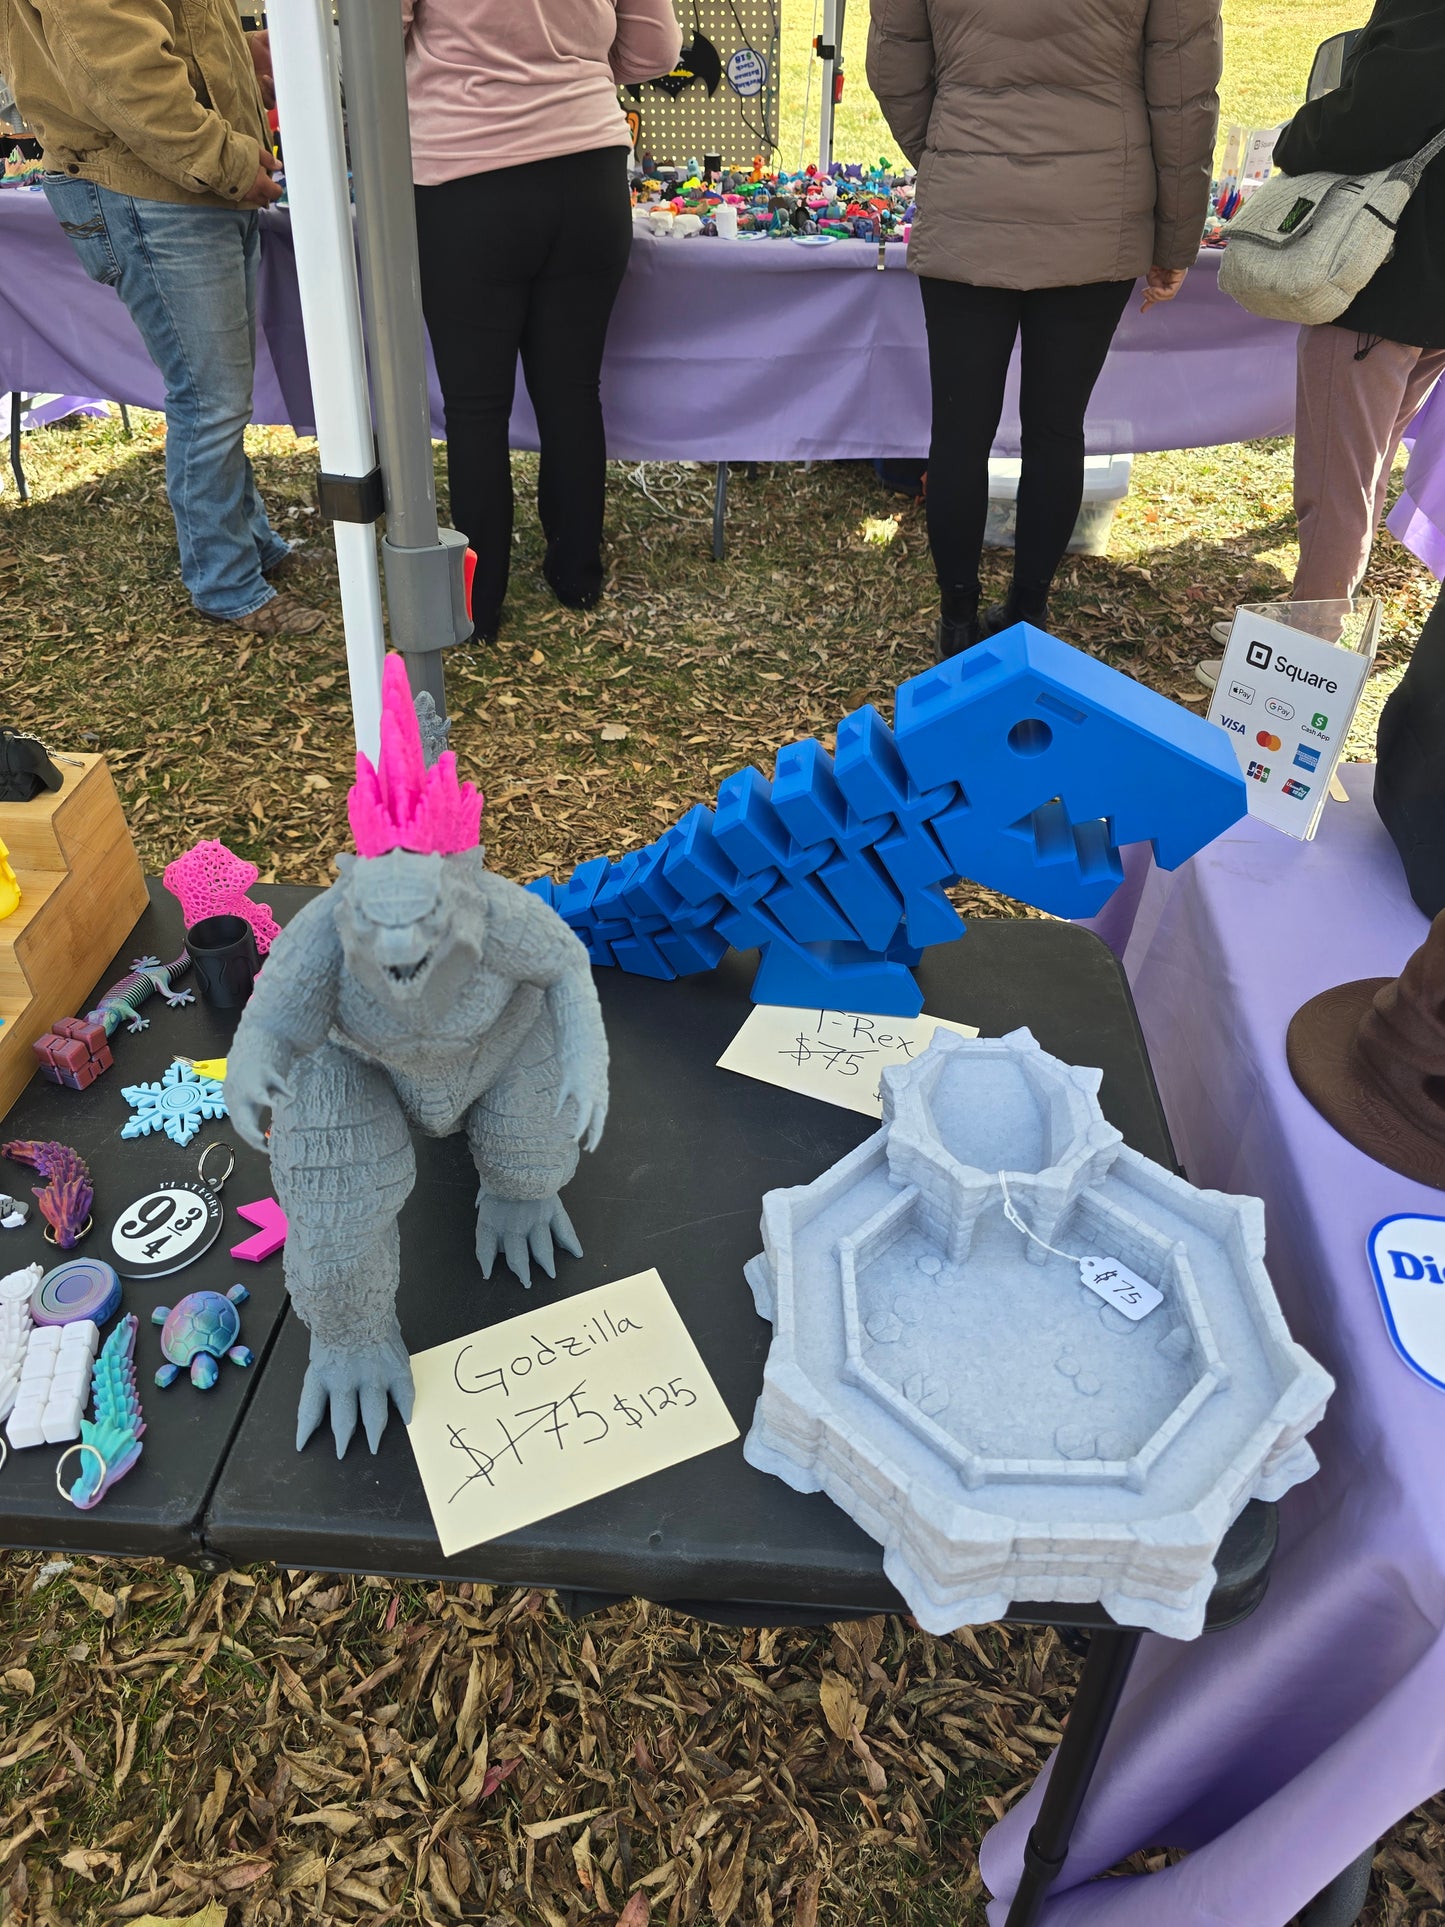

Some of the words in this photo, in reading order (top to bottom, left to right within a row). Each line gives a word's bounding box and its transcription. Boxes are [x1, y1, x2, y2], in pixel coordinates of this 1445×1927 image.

[734, 69, 760, 80] Batman
[736, 61, 755, 71] Clock
[1274, 655, 1338, 694] Square
[1238, 688, 1252, 700] Pay
[1277, 705, 1291, 717] Pay
[1220, 714, 1246, 735] VISA
[1301, 724, 1317, 736] Cash
[1316, 731, 1331, 743] App
[1248, 764, 1270, 781] JCB
[790, 1032, 865, 1076] $75
[120, 1195, 177, 1240] 9
[160, 1181, 219, 1218] PLATFORM
[1387, 1249, 1445, 1285] Di
[1093, 1269, 1142, 1305] $75
[454, 1309, 643, 1397] Godzilla
[446, 1388, 609, 1487] $175
[613, 1377, 697, 1429] $125
